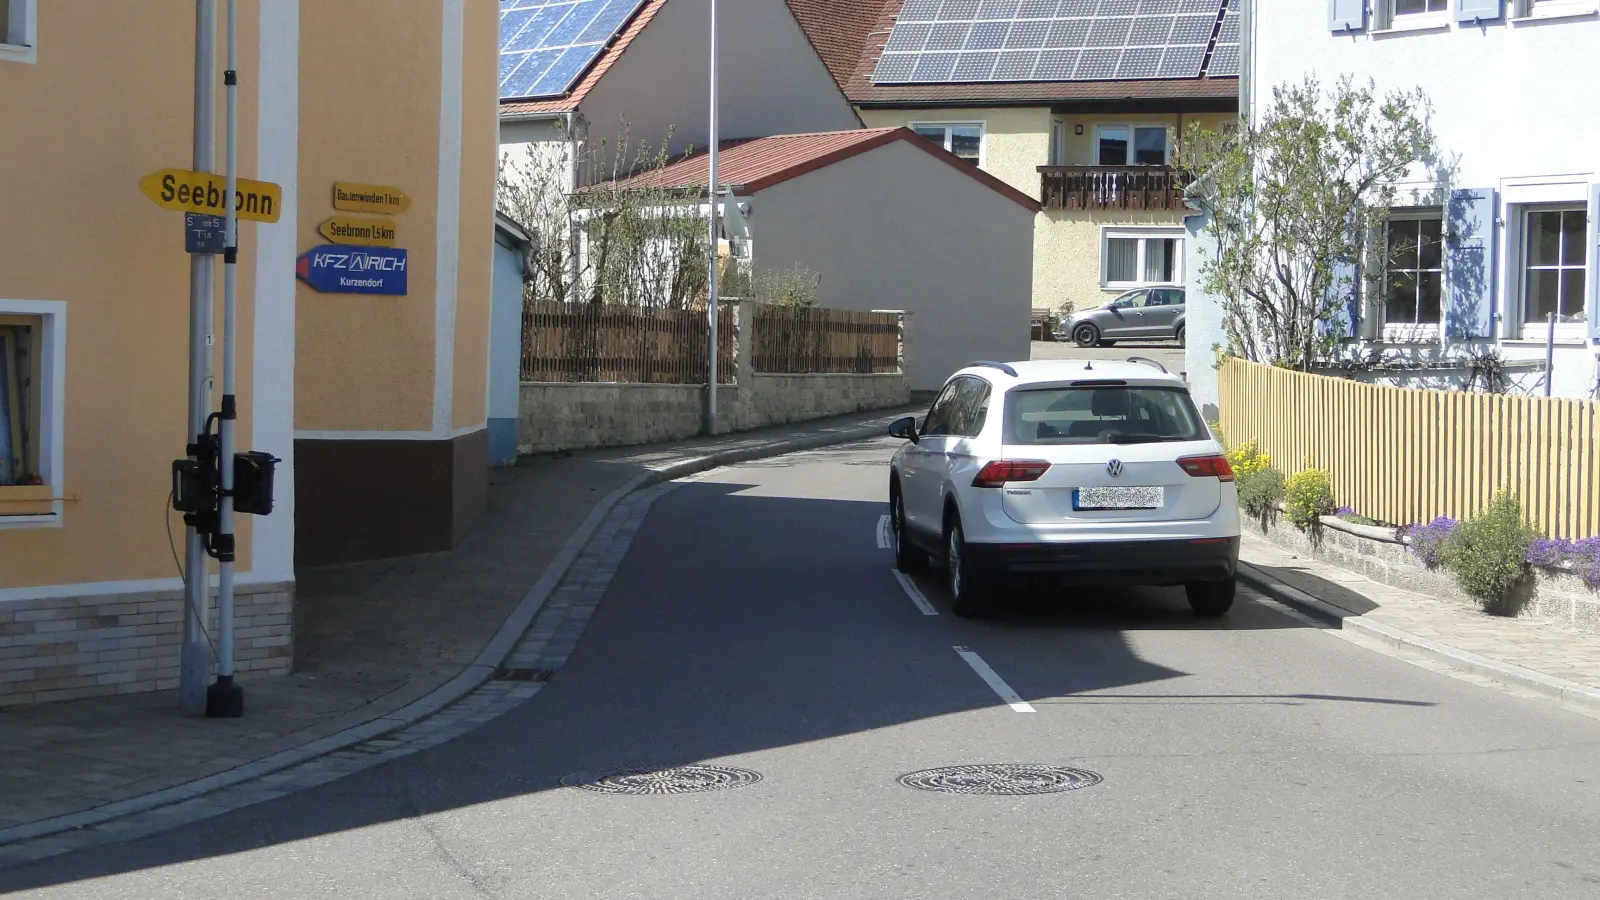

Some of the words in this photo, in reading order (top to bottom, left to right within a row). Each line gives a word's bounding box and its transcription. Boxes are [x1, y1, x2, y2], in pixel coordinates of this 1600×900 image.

[384, 193, 388, 205] 1
[389, 194, 400, 205] km
[330, 221, 371, 238] Seebronn
[382, 226, 395, 240] km
[313, 253, 349, 269] KFZ
[340, 276, 384, 287] Kurzendorf
